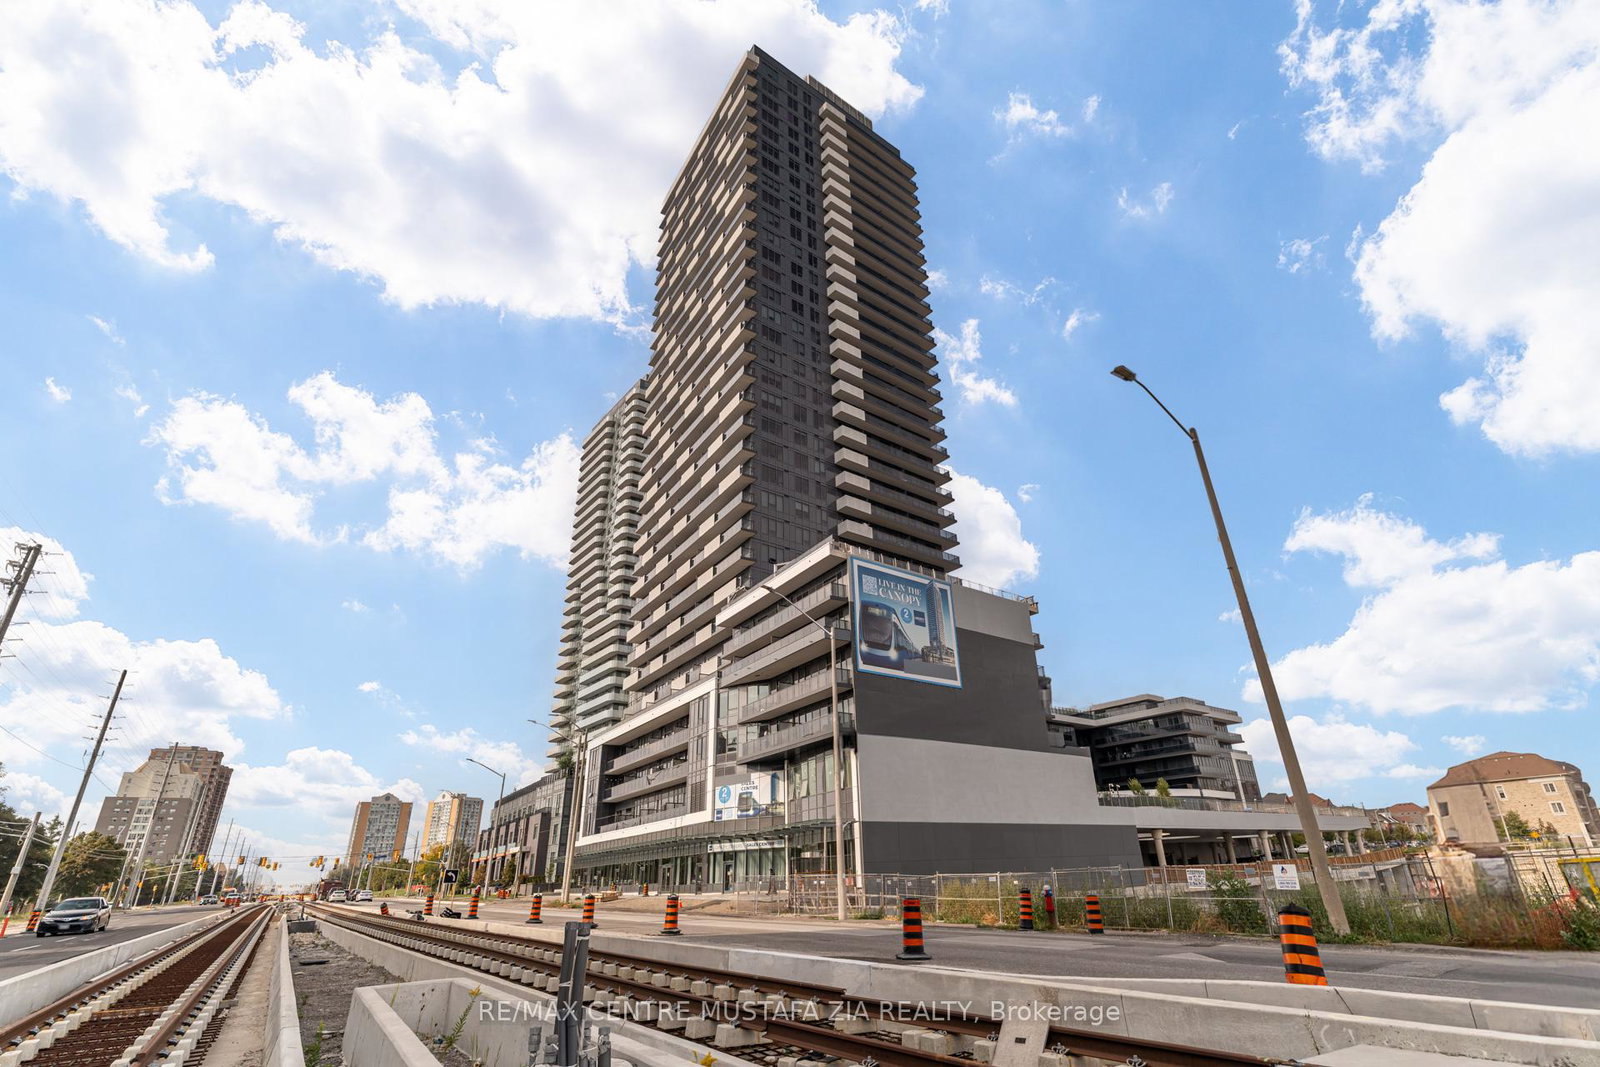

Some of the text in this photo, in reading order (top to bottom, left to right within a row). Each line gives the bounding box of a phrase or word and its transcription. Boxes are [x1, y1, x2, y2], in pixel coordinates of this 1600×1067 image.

[878, 578, 921, 596] LIVE IN THE
[879, 587, 921, 606] CANOPY
[903, 609, 909, 618] 2
[722, 788, 727, 797] 2
